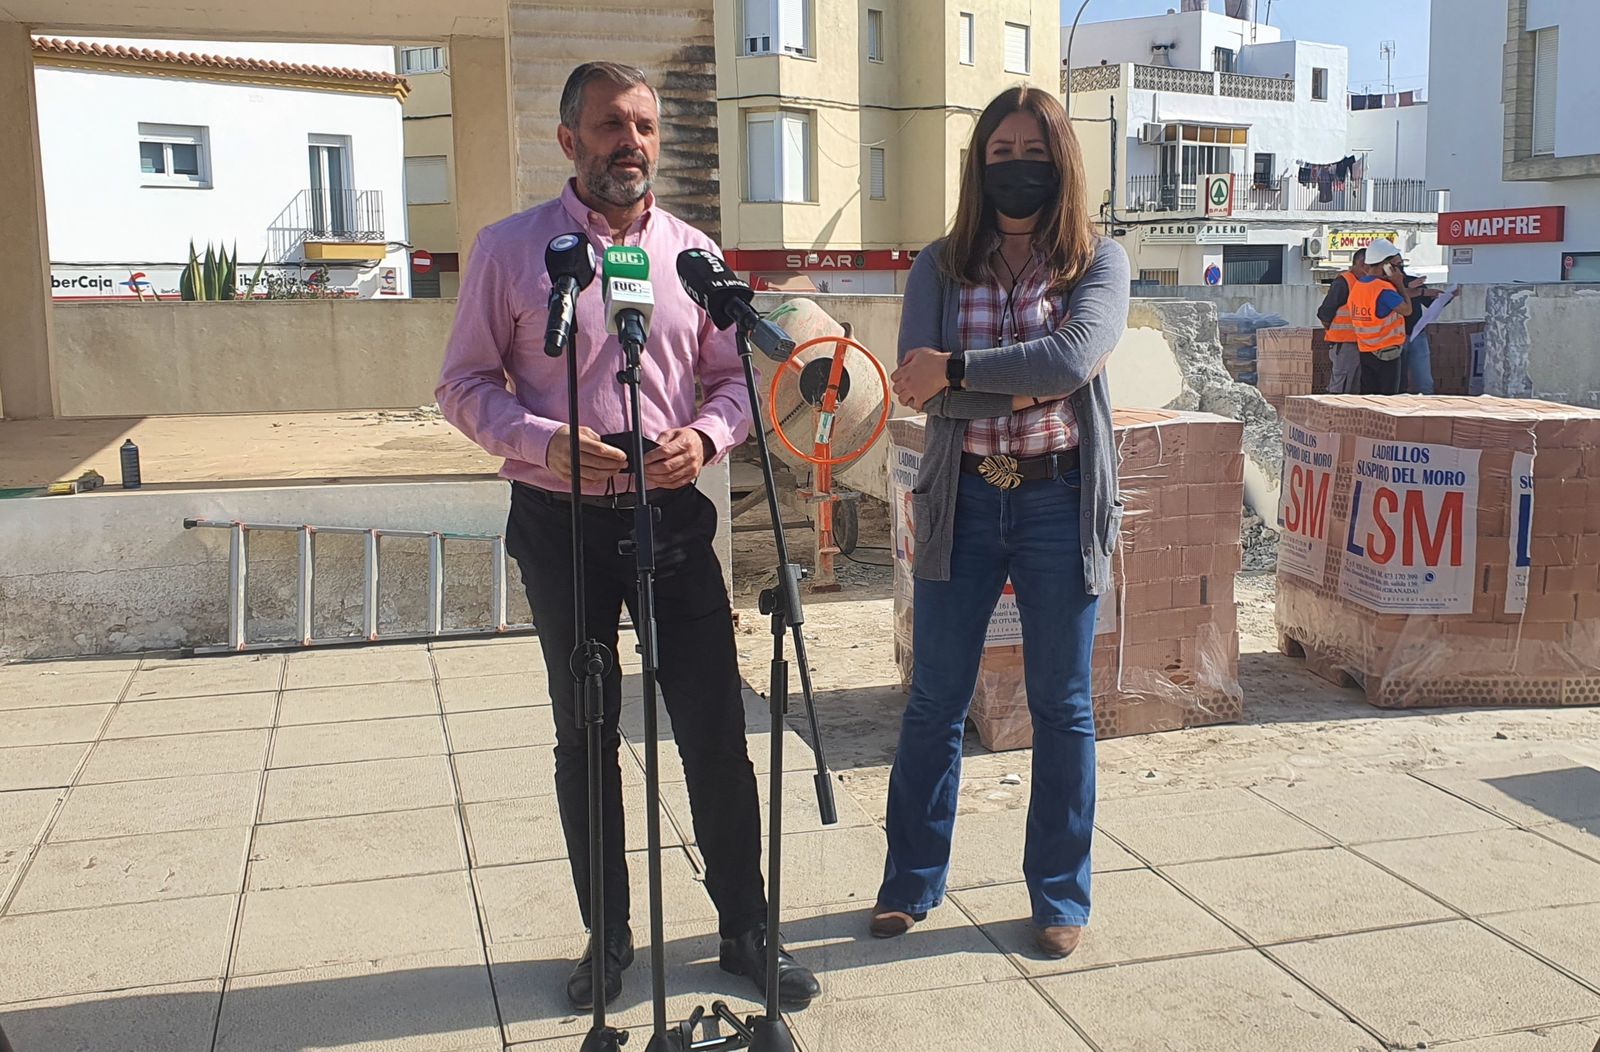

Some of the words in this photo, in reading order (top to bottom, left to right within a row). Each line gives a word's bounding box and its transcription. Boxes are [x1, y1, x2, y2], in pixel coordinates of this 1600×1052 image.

[1150, 225, 1196, 234] PLENO
[1206, 225, 1246, 234] PLENO
[1464, 215, 1541, 237] MAPFRE
[1340, 237, 1355, 247] DON
[786, 254, 852, 268] SPAR
[1289, 425, 1317, 449] LADRILLOS
[1284, 442, 1300, 461] SPIRO
[1301, 447, 1312, 465] DEL
[1313, 452, 1333, 469] MORO
[1372, 443, 1430, 464] LADRILLOS
[1356, 459, 1390, 482] SUSPIRO
[1392, 467, 1418, 484] DEL
[1422, 469, 1466, 486] MORO
